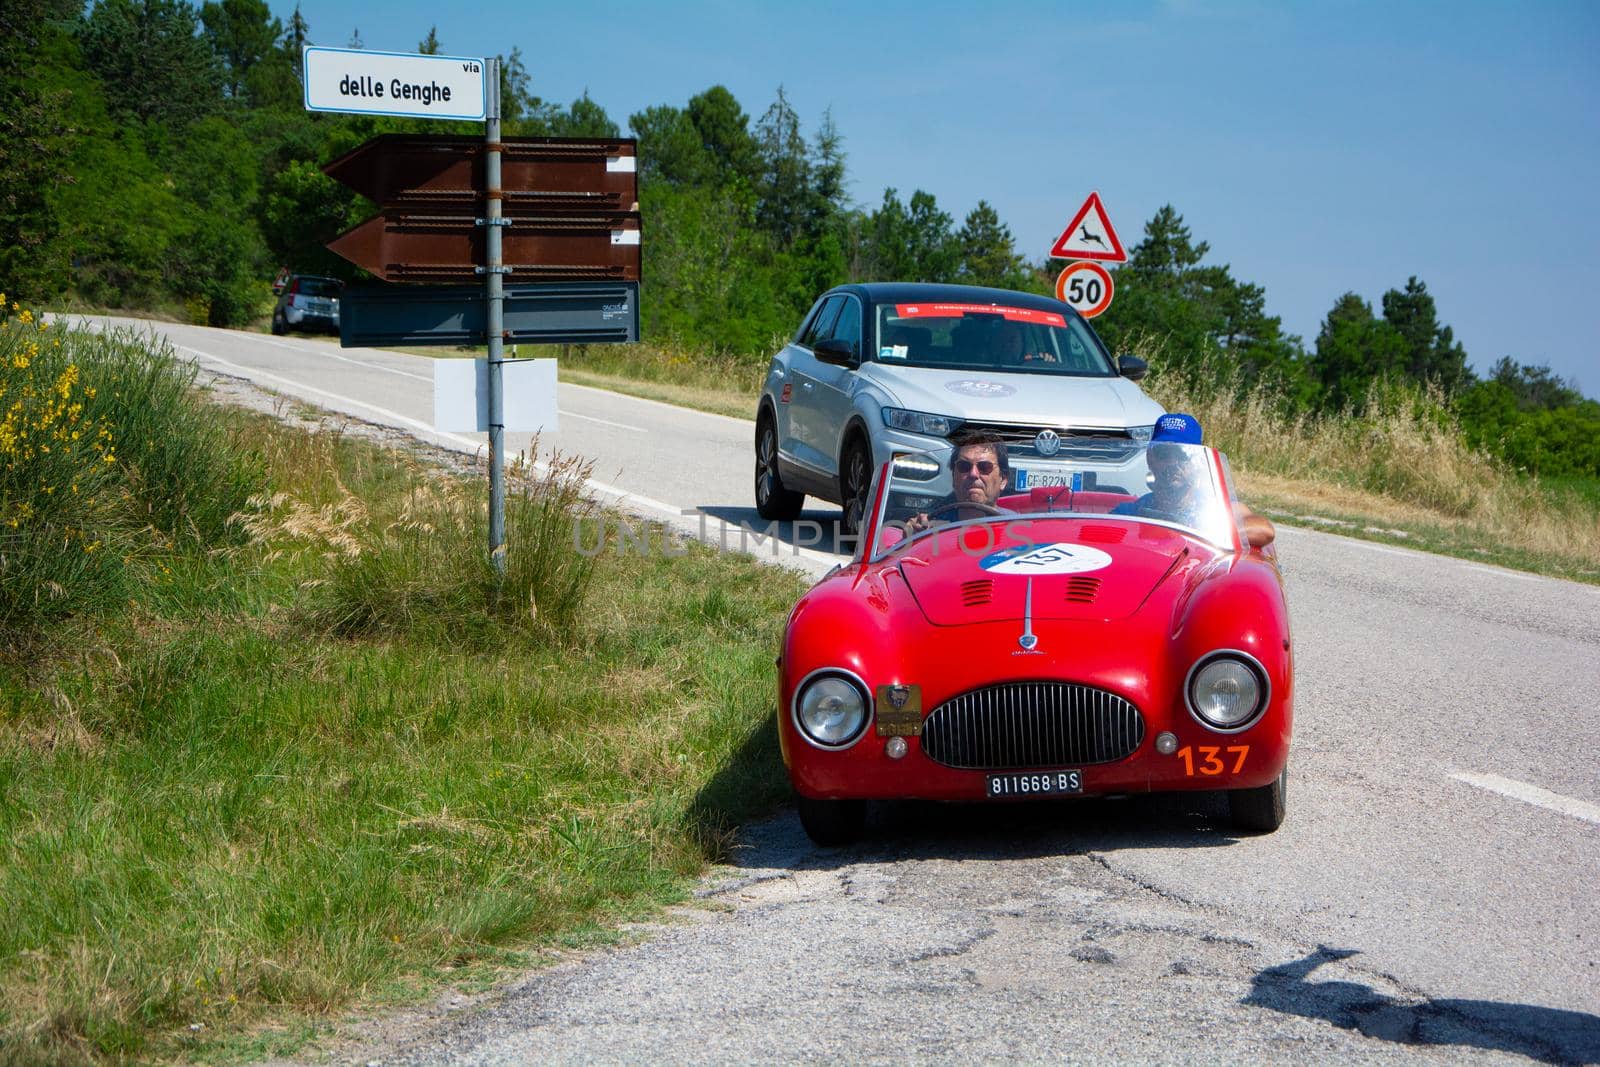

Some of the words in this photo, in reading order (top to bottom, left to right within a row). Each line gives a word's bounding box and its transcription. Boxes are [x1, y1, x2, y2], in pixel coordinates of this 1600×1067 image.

[463, 62, 479, 73] via
[340, 74, 384, 97] delle
[391, 79, 451, 105] Genghe
[1069, 279, 1101, 304] 50
[1014, 548, 1075, 566] 137
[1177, 745, 1250, 776] 137
[992, 776, 1050, 794] 811668
[1058, 773, 1079, 790] BS
